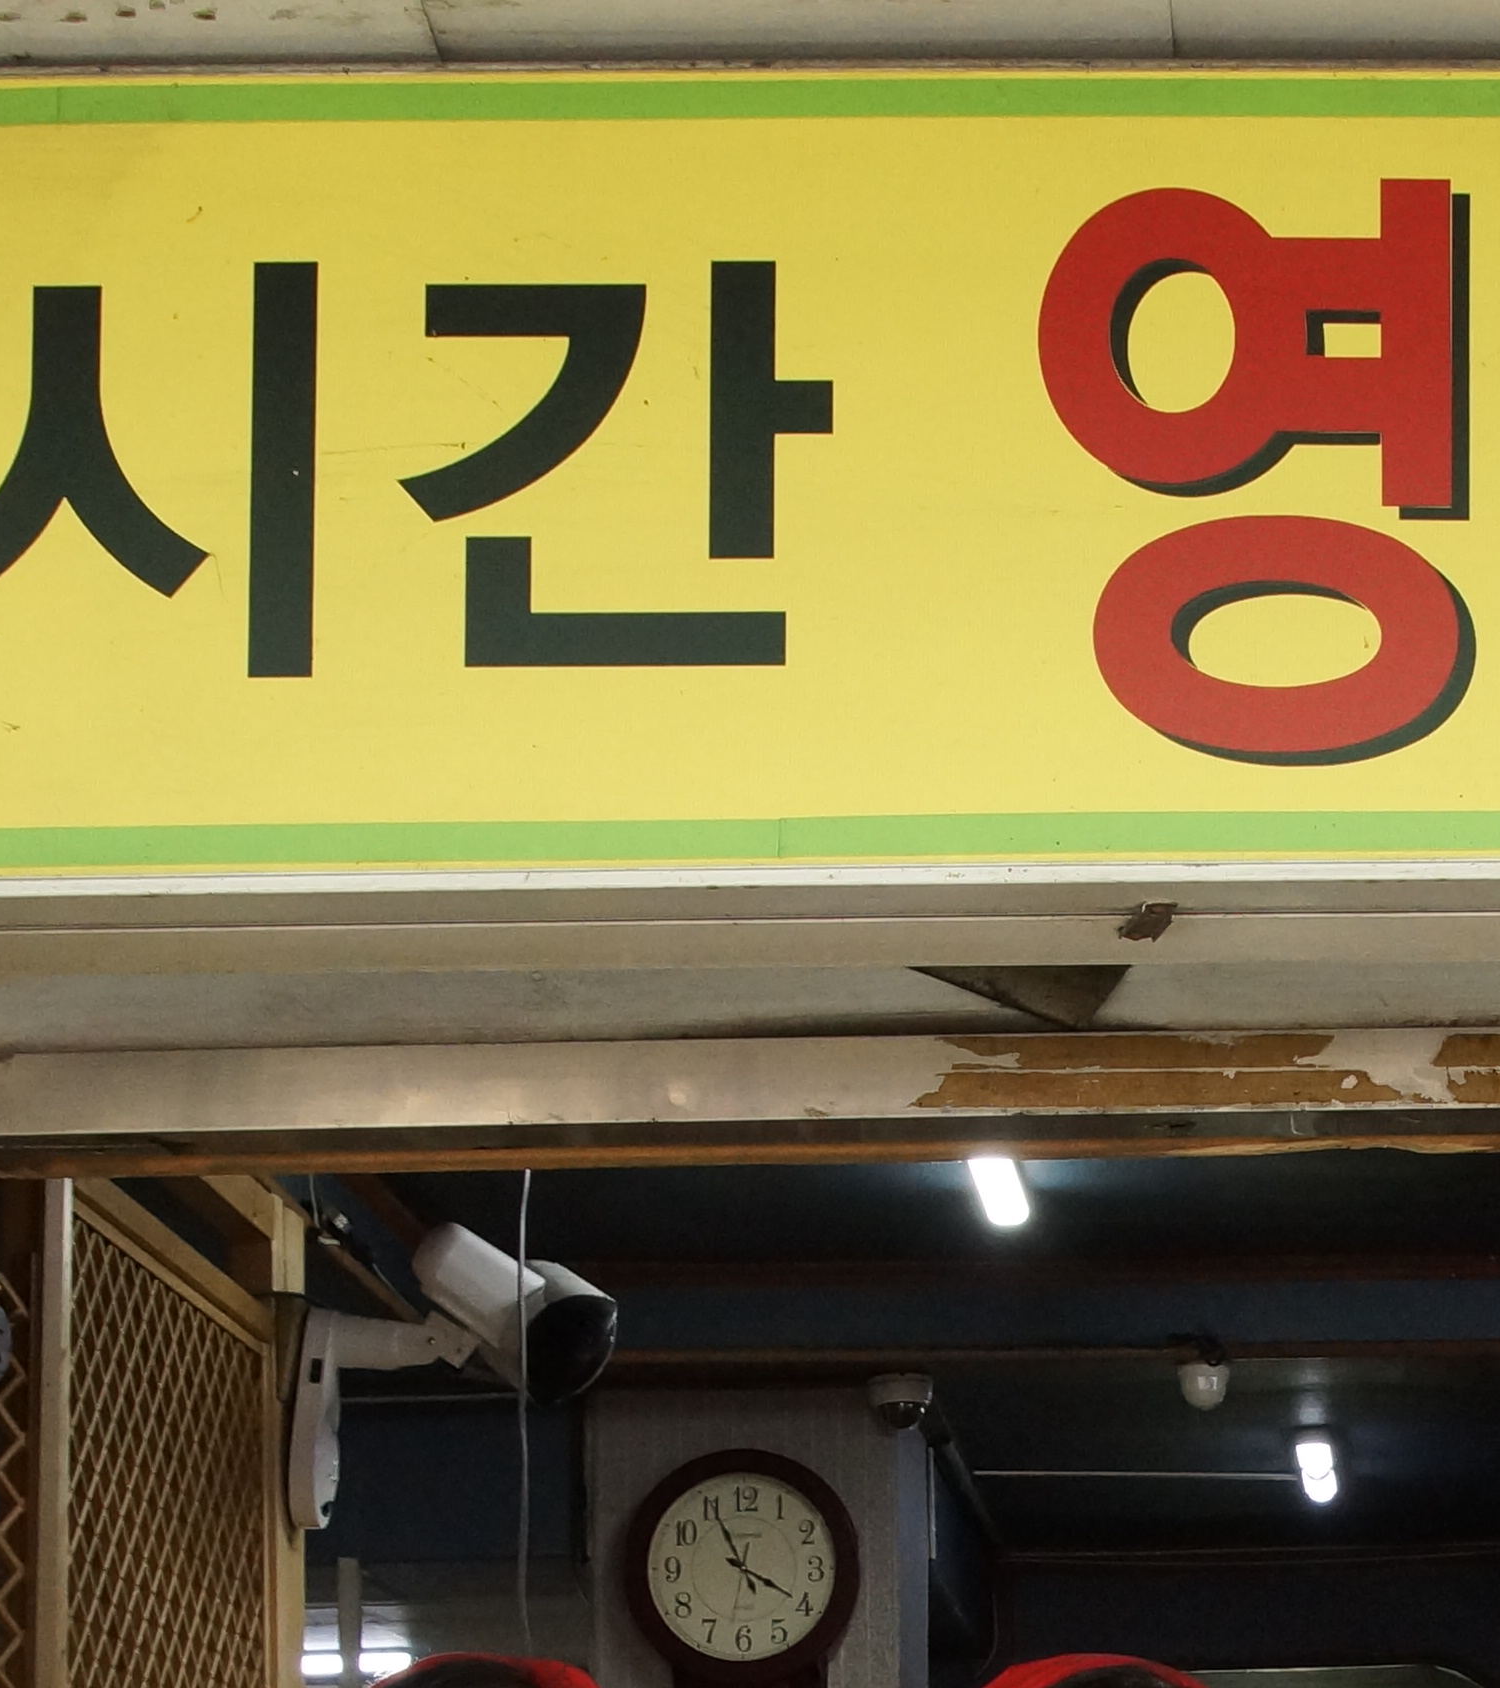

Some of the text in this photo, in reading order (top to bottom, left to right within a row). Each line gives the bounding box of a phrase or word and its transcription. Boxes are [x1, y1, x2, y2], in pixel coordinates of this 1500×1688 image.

[733, 1486, 759, 1512] 12
[775, 1494, 785, 1521] 1
[674, 1519, 698, 1546] 10
[799, 1519, 816, 1546] 2
[663, 1556, 682, 1582] 9
[807, 1555, 825, 1582] 3
[673, 1591, 692, 1618] 8
[795, 1591, 815, 1617] 4
[701, 1618, 717, 1644] 7
[734, 1625, 752, 1653] 6
[770, 1618, 789, 1645] 5
